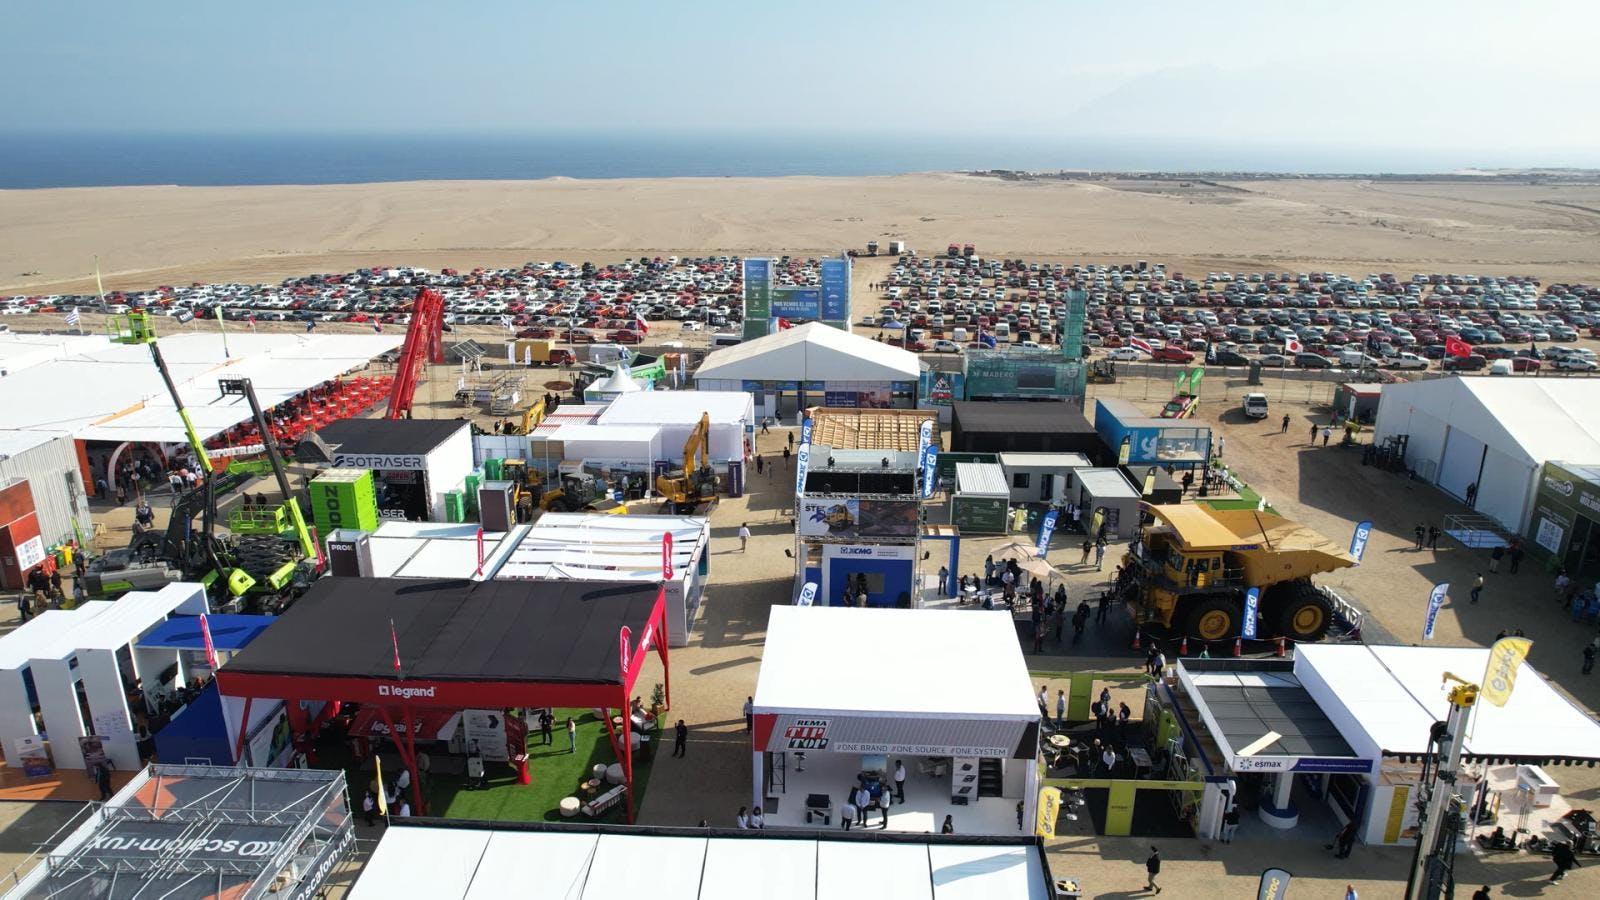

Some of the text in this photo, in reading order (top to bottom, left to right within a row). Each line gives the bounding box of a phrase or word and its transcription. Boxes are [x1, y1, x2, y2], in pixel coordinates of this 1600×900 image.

[347, 457, 422, 468] SOTRASER
[391, 686, 435, 698] legrand
[788, 727, 825, 738] TIP
[792, 739, 828, 749] TOP
[860, 744, 888, 752] BRAND
[916, 745, 946, 754] SOURCE
[974, 747, 1006, 756] SYSTEM
[1254, 760, 1282, 768] esmax
